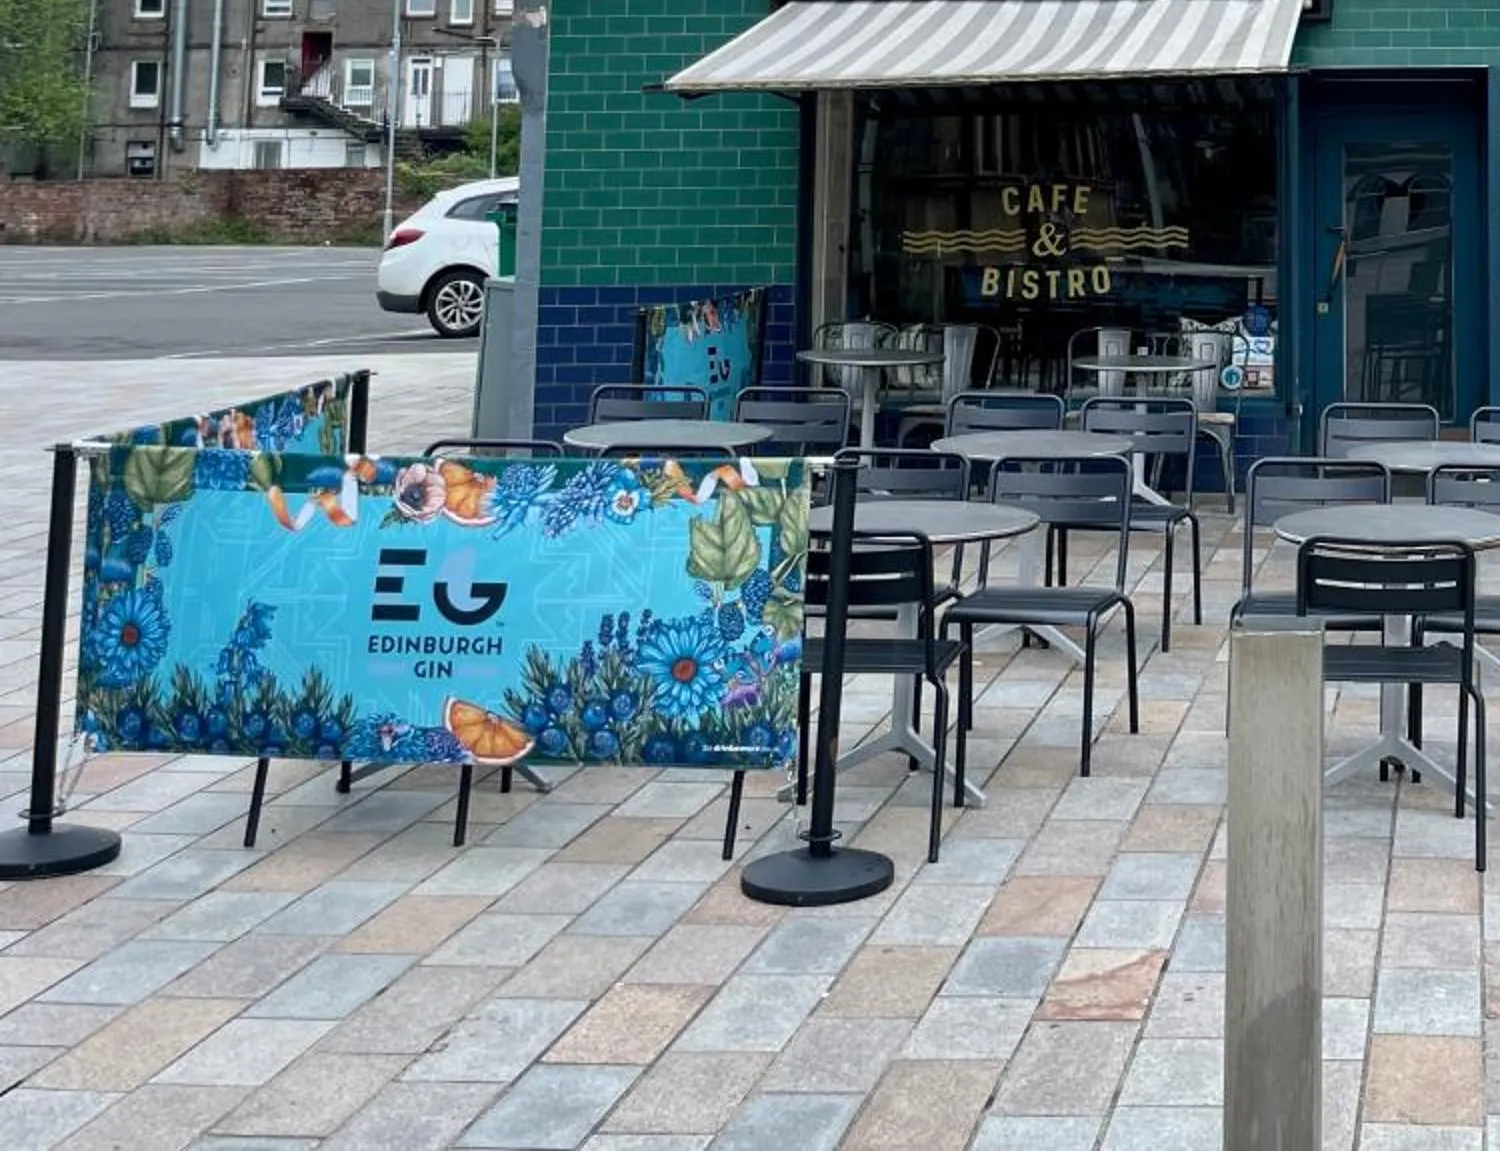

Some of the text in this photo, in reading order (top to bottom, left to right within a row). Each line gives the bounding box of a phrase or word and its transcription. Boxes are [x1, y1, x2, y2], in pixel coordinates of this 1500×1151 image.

[1002, 184, 1092, 216] CAFE
[1032, 222, 1067, 257] &
[981, 265, 1112, 300] BISTRO
[371, 548, 508, 626] EG
[367, 634, 503, 656] EDINBURGH
[413, 659, 453, 679] GIN
